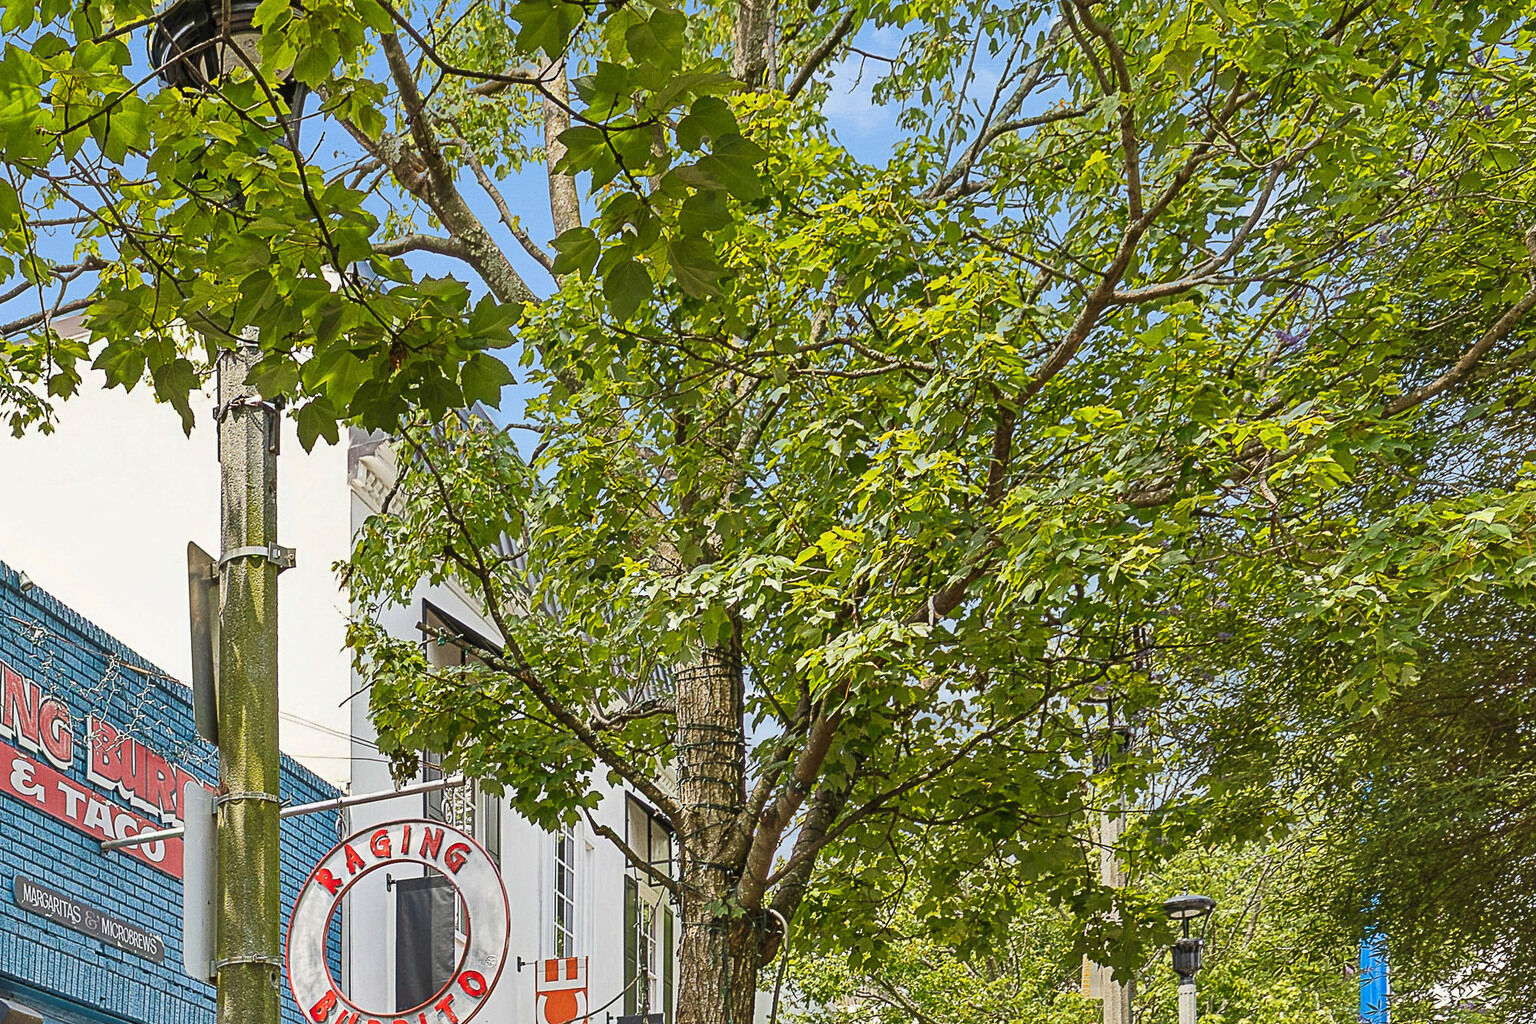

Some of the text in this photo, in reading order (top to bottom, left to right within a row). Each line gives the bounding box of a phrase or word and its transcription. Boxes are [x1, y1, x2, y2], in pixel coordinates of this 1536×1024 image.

[11, 753, 167, 864] & TACO
[87, 715, 186, 826] BUR
[314, 824, 472, 896] RAGING
[21, 883, 157, 956] MARGARITAS & MICROBREWS
